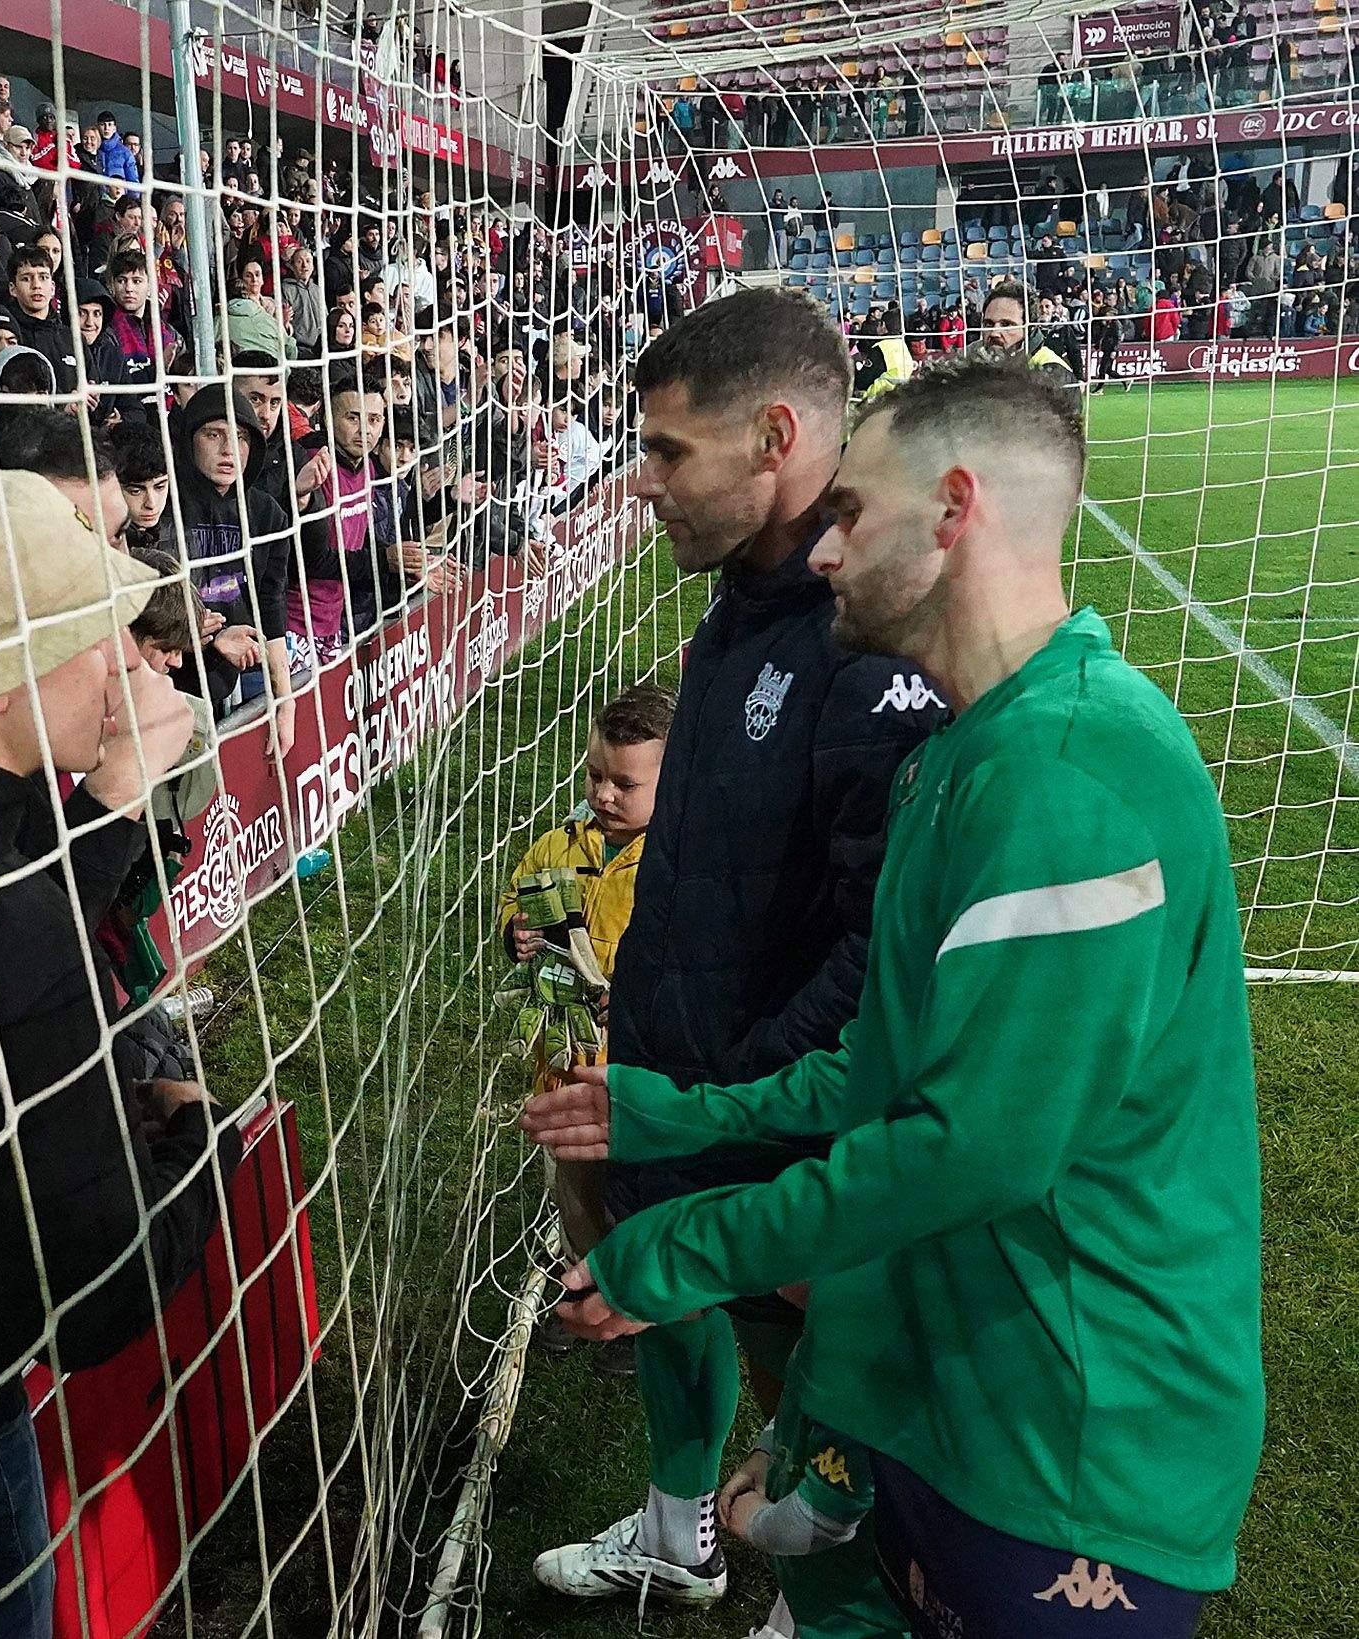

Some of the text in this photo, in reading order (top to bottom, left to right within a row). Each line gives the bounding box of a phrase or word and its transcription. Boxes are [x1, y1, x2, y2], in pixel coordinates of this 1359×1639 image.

[1113, 20, 1171, 34] Deputación
[1113, 30, 1171, 43] Pontevedra
[1273, 111, 1326, 132] IDC
[992, 131, 1085, 156] TALLERES
[169, 805, 285, 943] PESCAMAR
